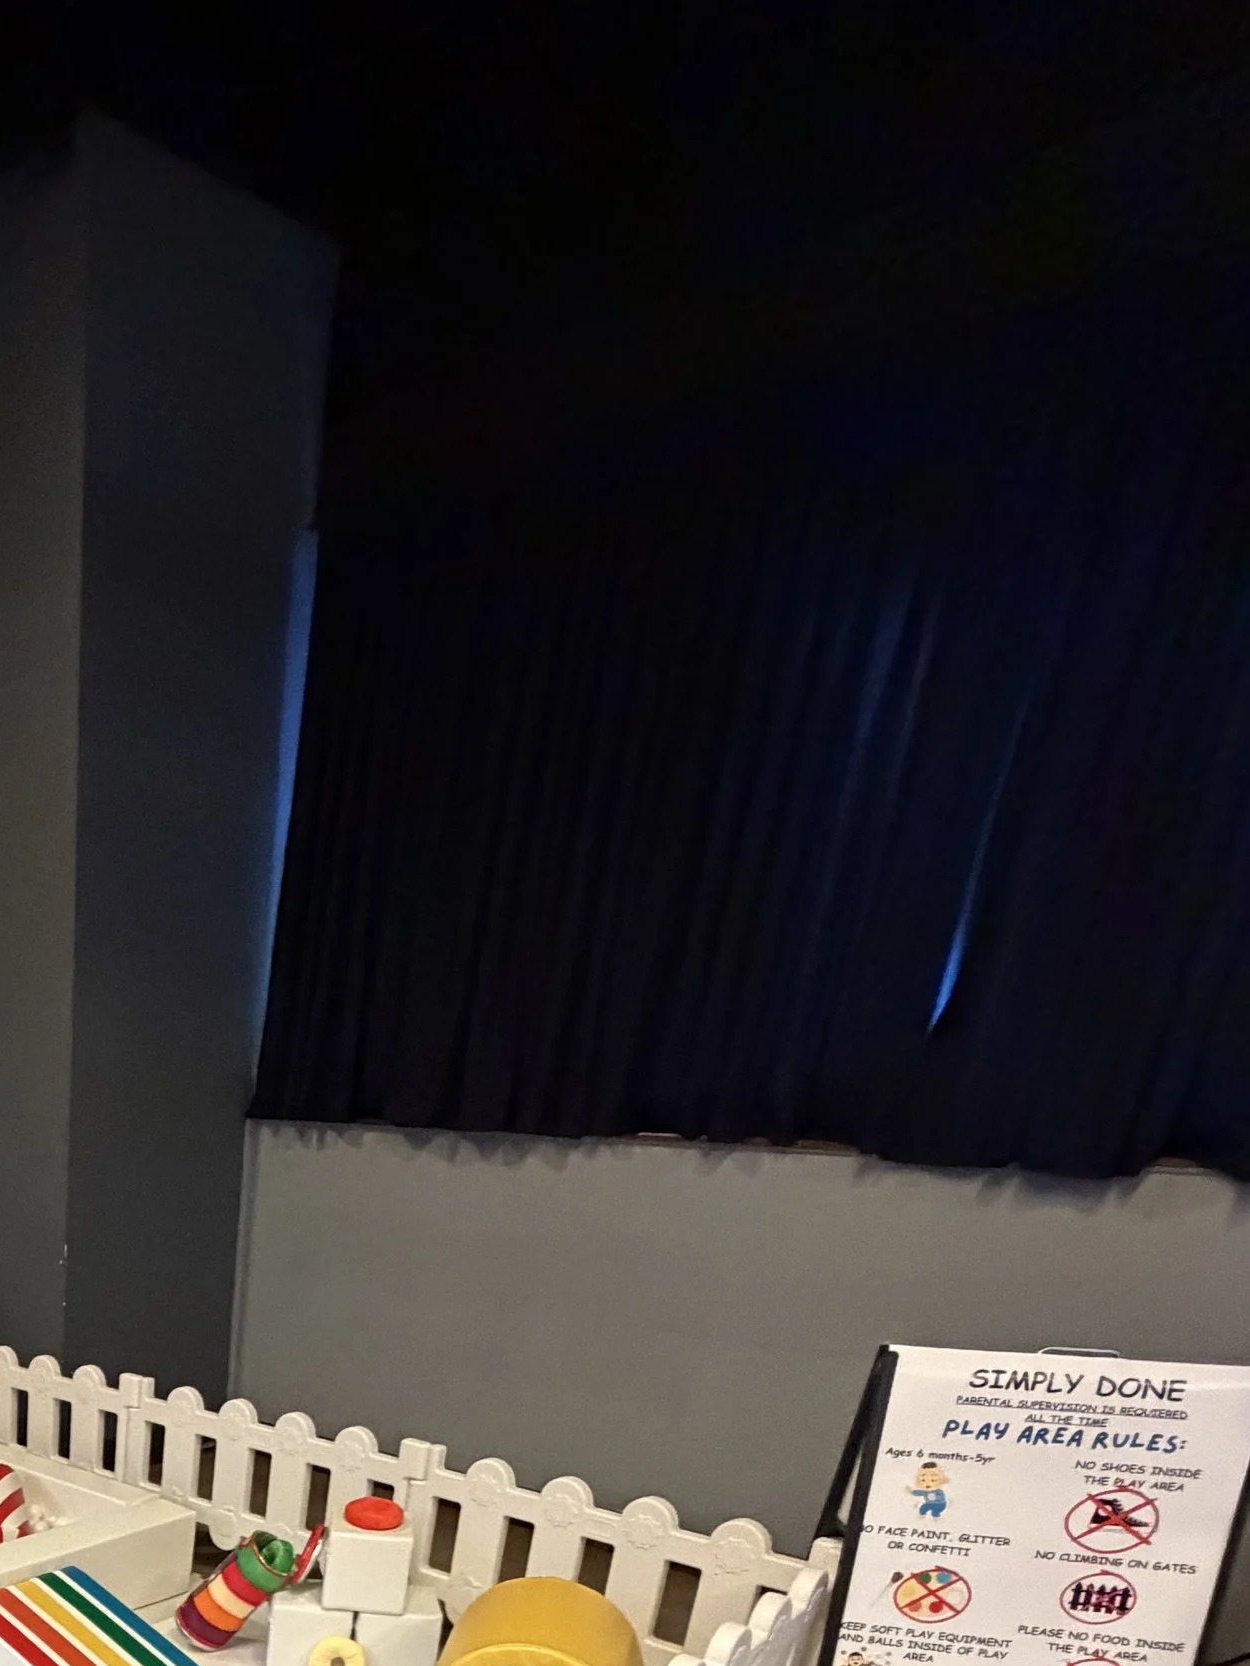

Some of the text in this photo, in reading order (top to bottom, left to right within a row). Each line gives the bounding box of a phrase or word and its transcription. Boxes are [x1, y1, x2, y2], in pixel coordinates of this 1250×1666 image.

[969, 1369, 1188, 1402] SIMPLY DONE
[956, 1395, 1013, 1408] PARENTAL
[1017, 1399, 1097, 1413] SUPERVISION
[1100, 1405, 1115, 1415] IS
[1025, 1413, 1109, 1427] ALL THE TIME
[942, 1419, 1187, 1453] PLAY AREA RULES:
[885, 1447, 913, 1458] Ages
[1075, 1460, 1202, 1480] NO SHOES INSIDE
[1084, 1475, 1184, 1492] THE PLAY AREA
[878, 1525, 908, 1537] FACE
[958, 1533, 1011, 1546] GLITTER
[888, 1540, 971, 1556] OR CONFETTI
[1034, 1550, 1198, 1574] NO CLIMBING ON GATES
[870, 1624, 902, 1635] SOFT
[905, 1628, 935, 1639] PLAY
[938, 1631, 1013, 1648] EQUIPMENT
[1017, 1625, 1186, 1652] PLEASE NO FOOD INSIDE
[839, 1633, 1009, 1660] AND BALLS INSIDE OF PLAY
[1047, 1642, 1148, 1662] THE PLAY AREA
[903, 1652, 934, 1663] AREA
